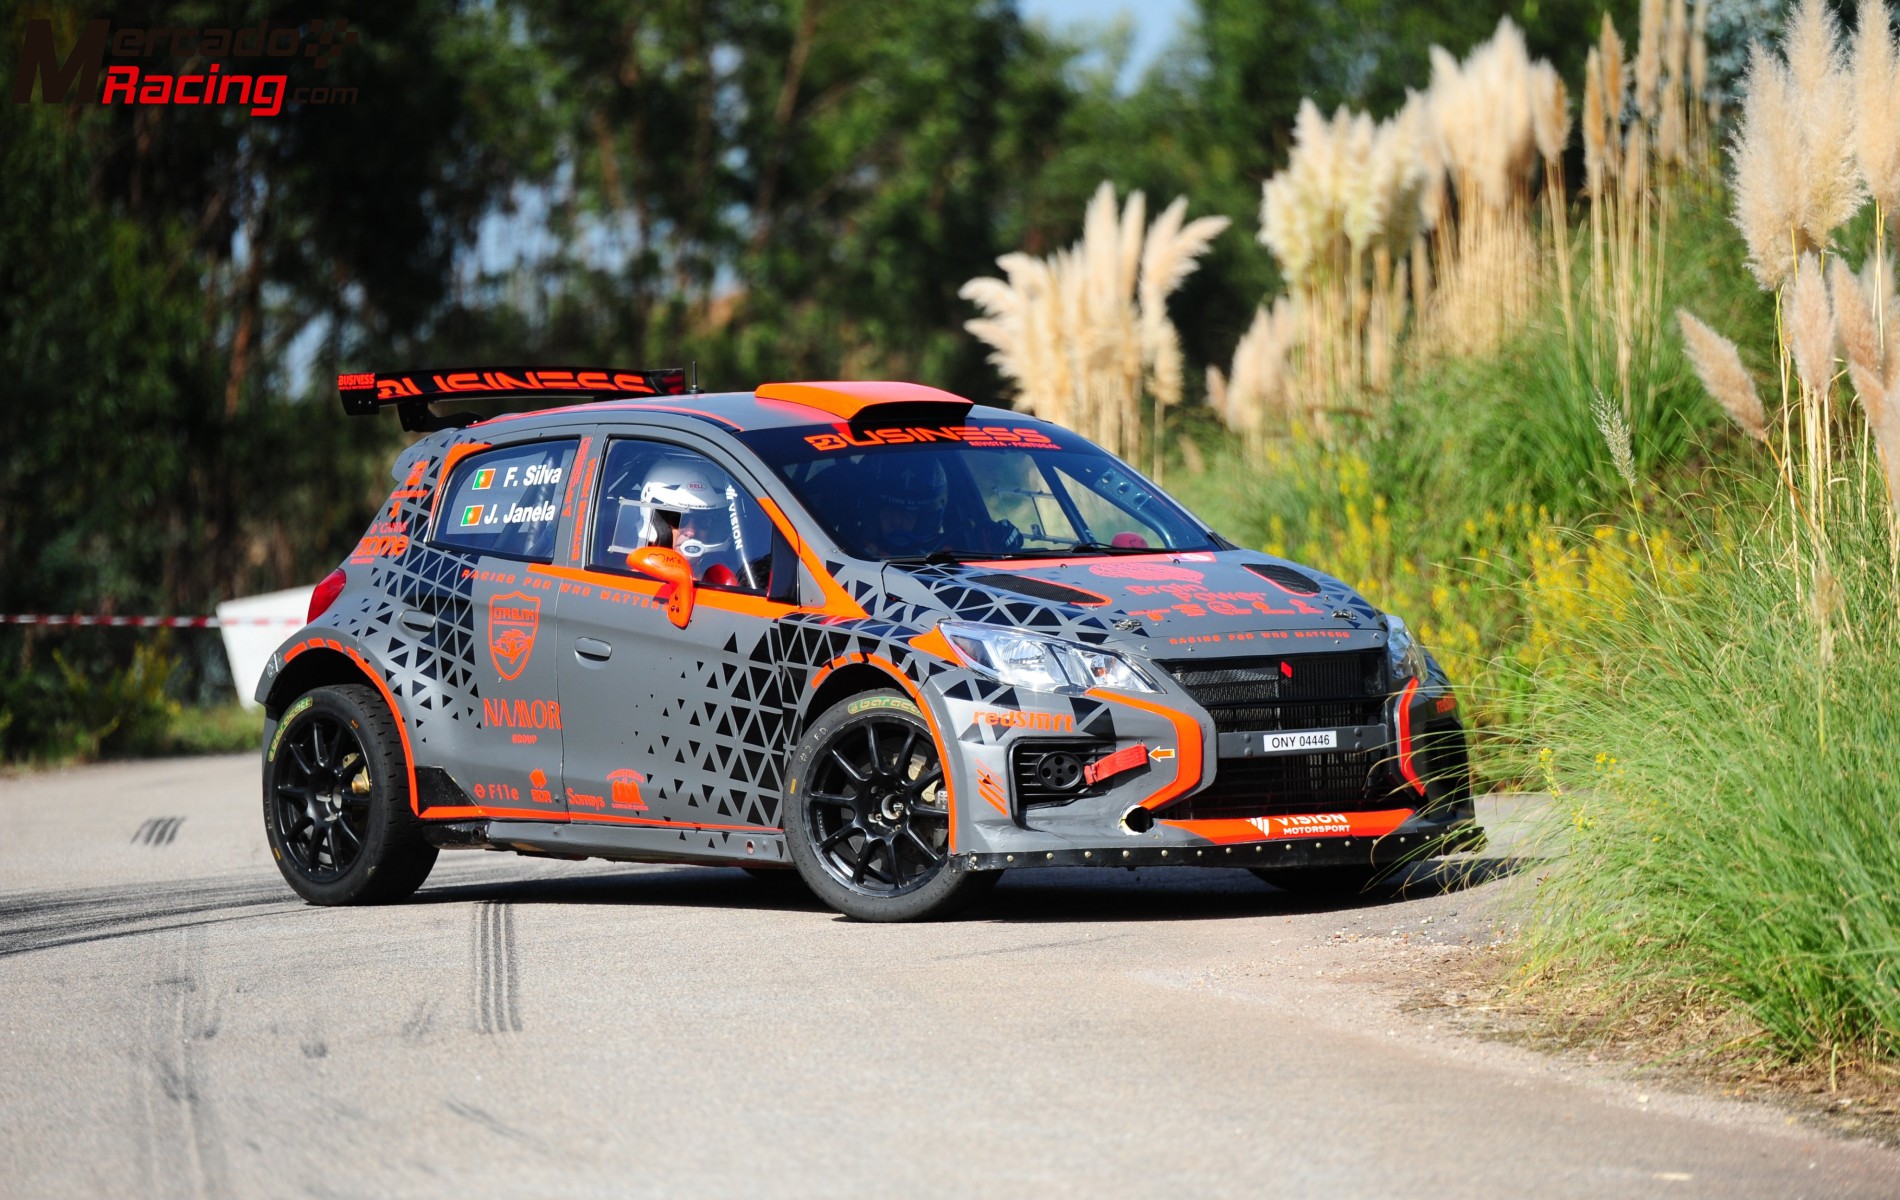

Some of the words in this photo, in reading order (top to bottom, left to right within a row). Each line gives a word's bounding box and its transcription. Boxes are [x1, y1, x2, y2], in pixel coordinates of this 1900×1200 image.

[338, 374, 375, 386] BUSINESS
[803, 426, 1052, 451] BUSINESS
[503, 466, 518, 487] F.
[523, 465, 562, 486] Silva
[484, 504, 499, 525] J.
[503, 500, 556, 523] Janela
[728, 502, 743, 550] VISION
[560, 583, 591, 596] WHO
[483, 697, 562, 729] NAMOR
[972, 710, 1073, 732] redShift
[1271, 736, 1296, 748] ONY
[1299, 734, 1330, 747] 04446
[1273, 813, 1348, 826] VISION
[1283, 825, 1350, 835] MOTORSPORT
